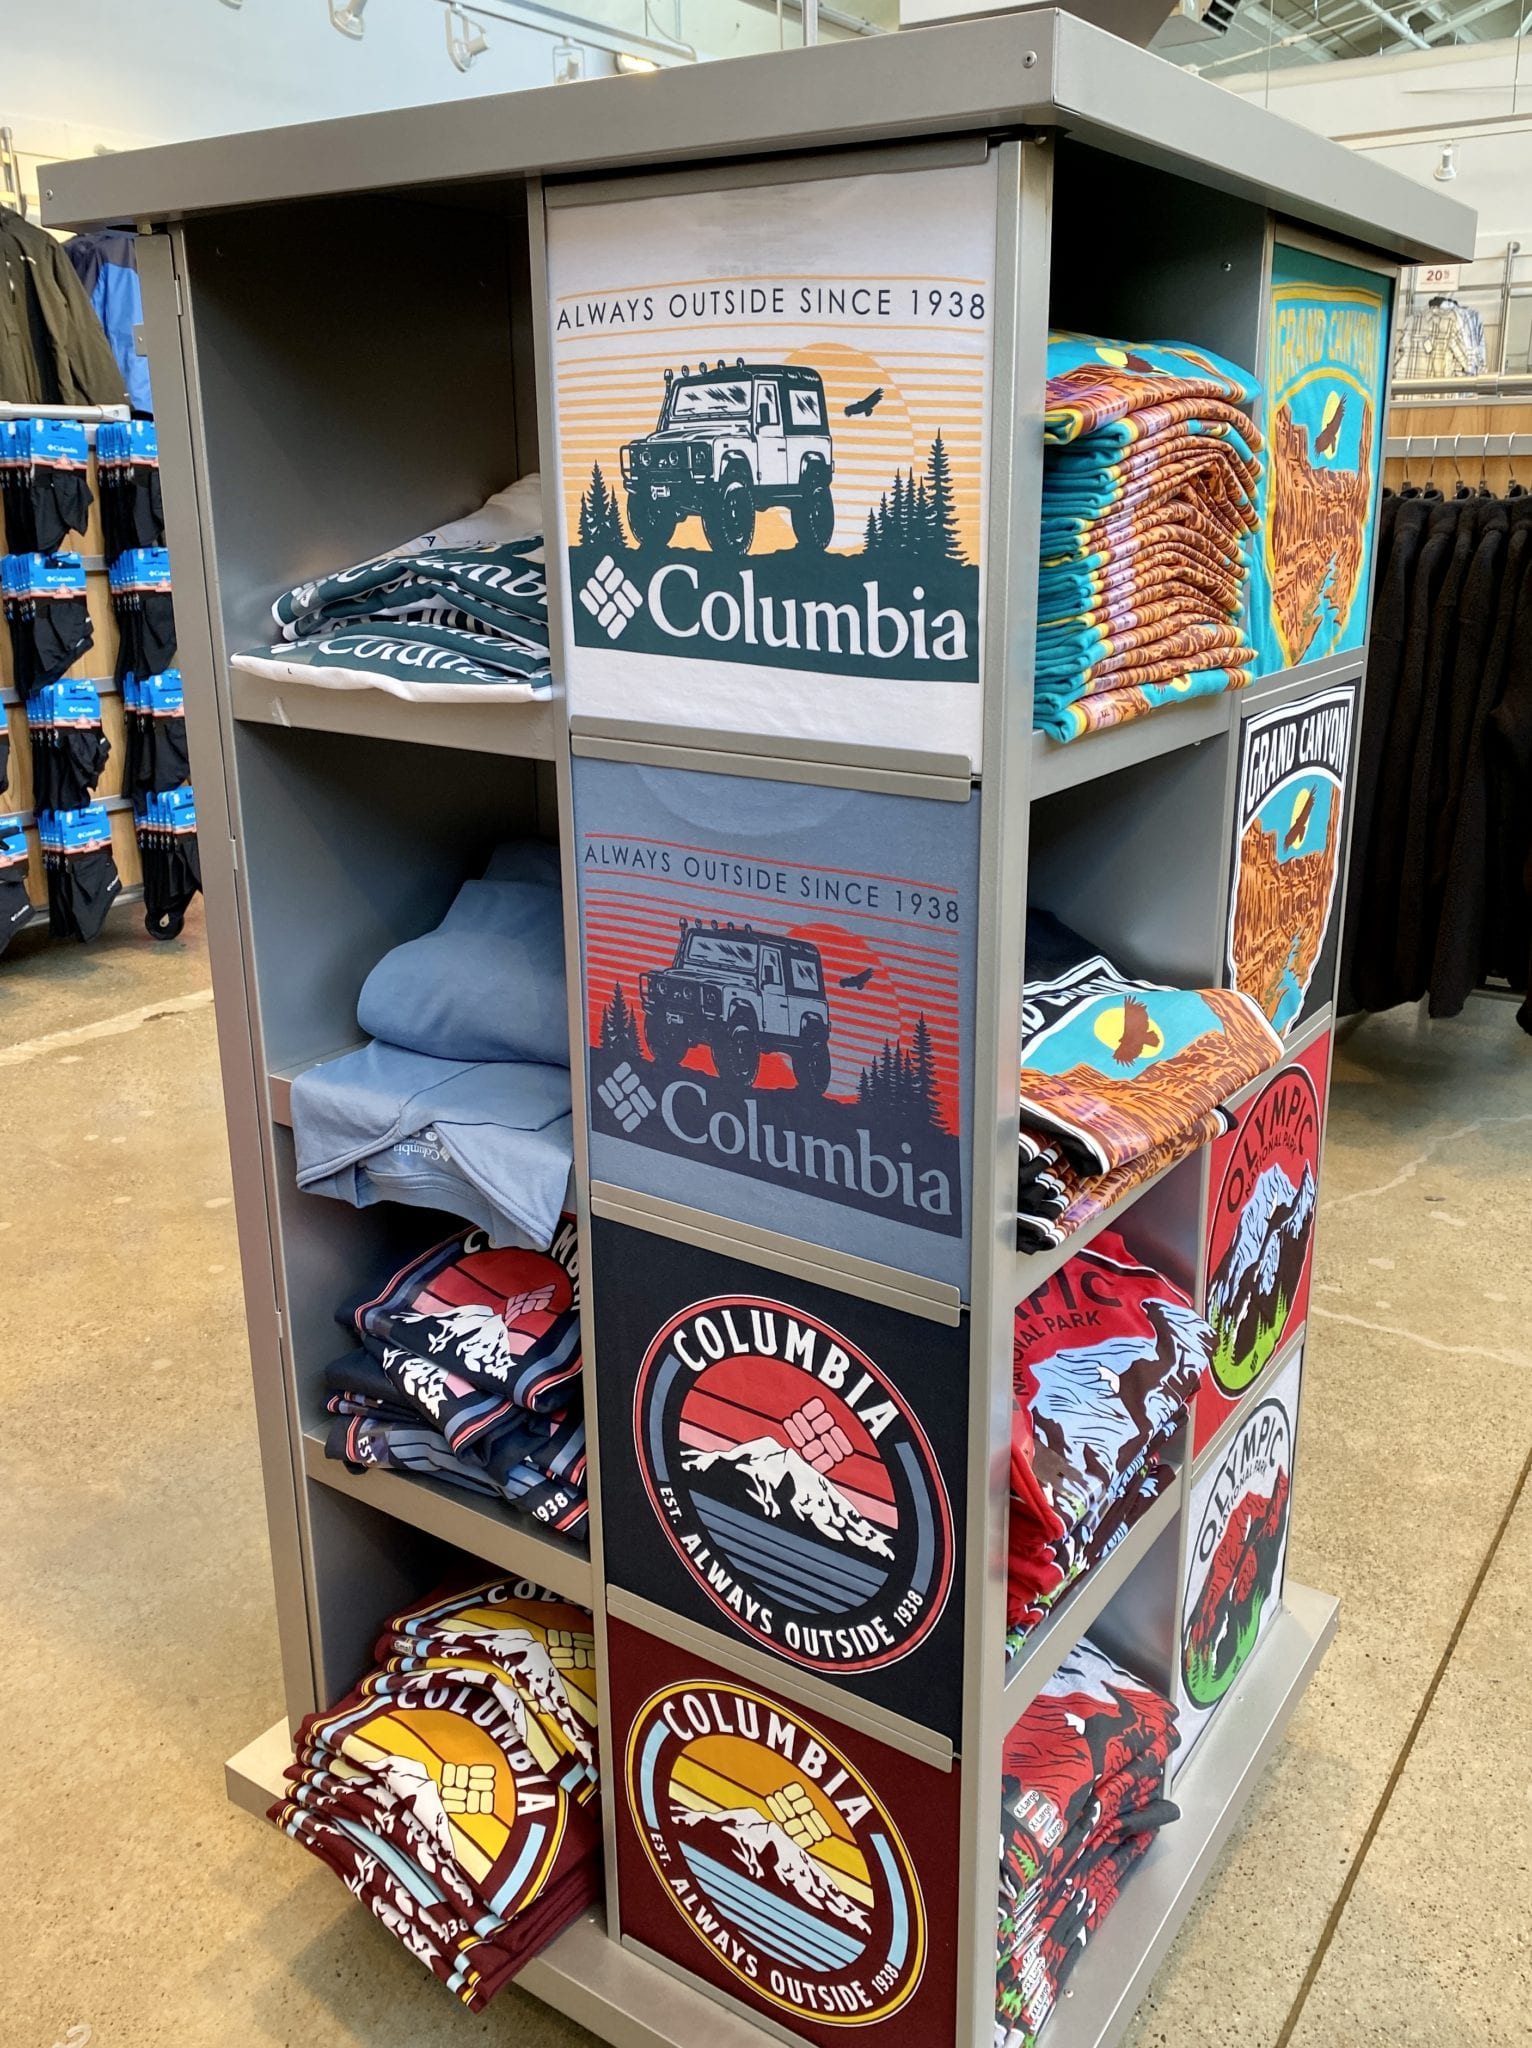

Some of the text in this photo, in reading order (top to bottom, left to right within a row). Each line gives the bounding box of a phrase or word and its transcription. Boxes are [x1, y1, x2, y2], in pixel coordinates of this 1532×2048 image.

[557, 288, 985, 331] ALWAYS OUTSIDE SINCE 1938
[647, 563, 969, 661] Columbia
[1246, 706, 1348, 814] GRAND CANYON
[584, 844, 960, 923] ALWAYS OUTSIDE SINCE 1938
[661, 1080, 952, 1215] Columbia
[1227, 1085, 1312, 1214] OLYMPIC
[1245, 1135, 1281, 1198] NATIONAL
[1043, 1310, 1102, 1333] PARK
[673, 1309, 899, 1441] COLUMBIA
[660, 1487, 682, 1524] EST.
[1199, 1415, 1283, 1563] OLYMPIC
[681, 1533, 896, 1659] ALWAYS OUTSIDE
[893, 1590, 924, 1629] 1938
[662, 1693, 873, 1828] COLUMBIA
[650, 1832, 672, 1868] EST.
[670, 1878, 873, 2013] ALWAYS OUTSIDE
[871, 1962, 899, 1996] 1938
